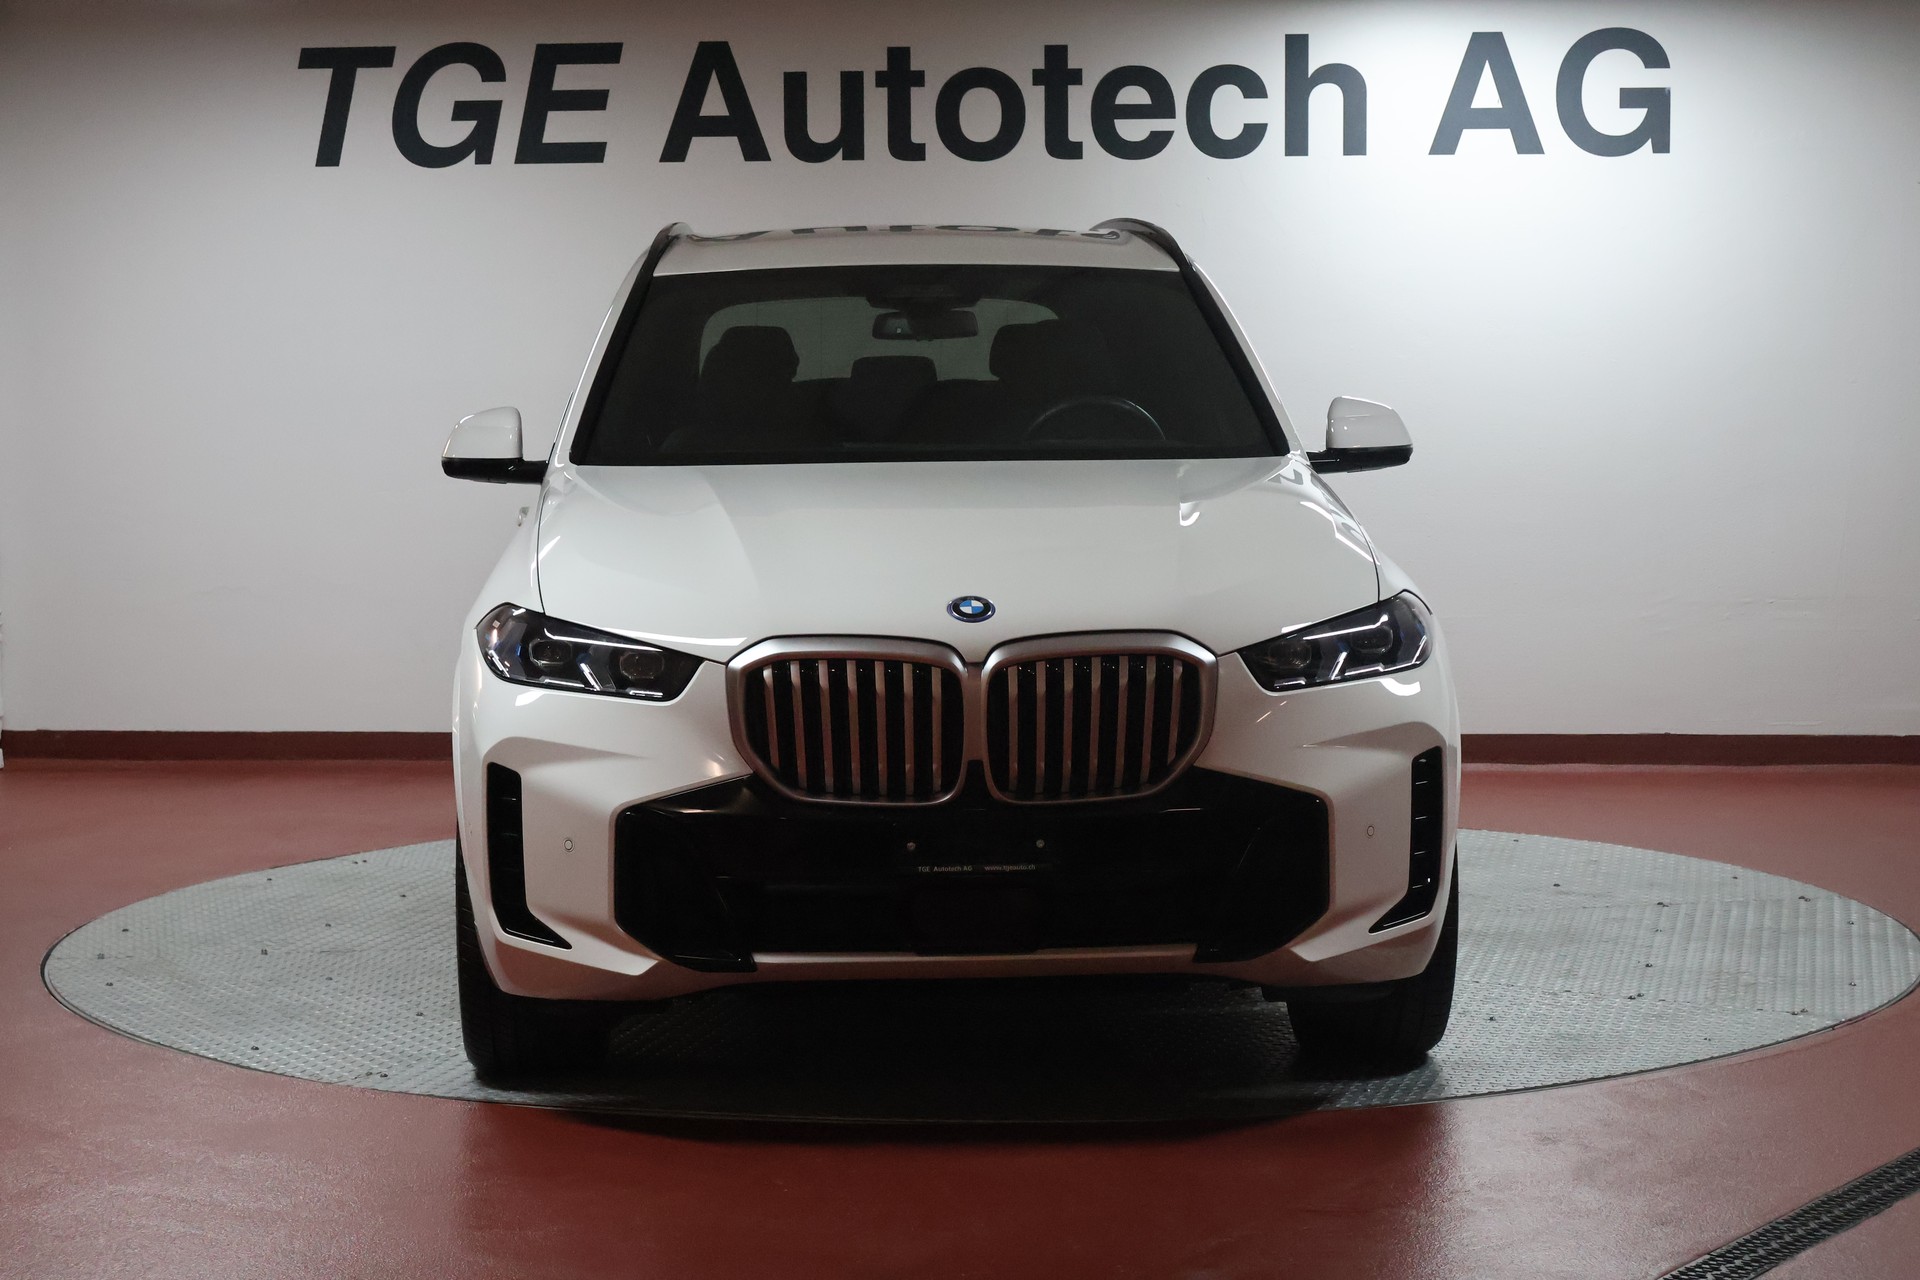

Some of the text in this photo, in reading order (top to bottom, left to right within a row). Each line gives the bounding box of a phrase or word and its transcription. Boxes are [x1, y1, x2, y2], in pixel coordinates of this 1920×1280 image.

[298, 27, 1671, 169] TGE Autotech AG
[933, 865, 962, 873] Autotech
